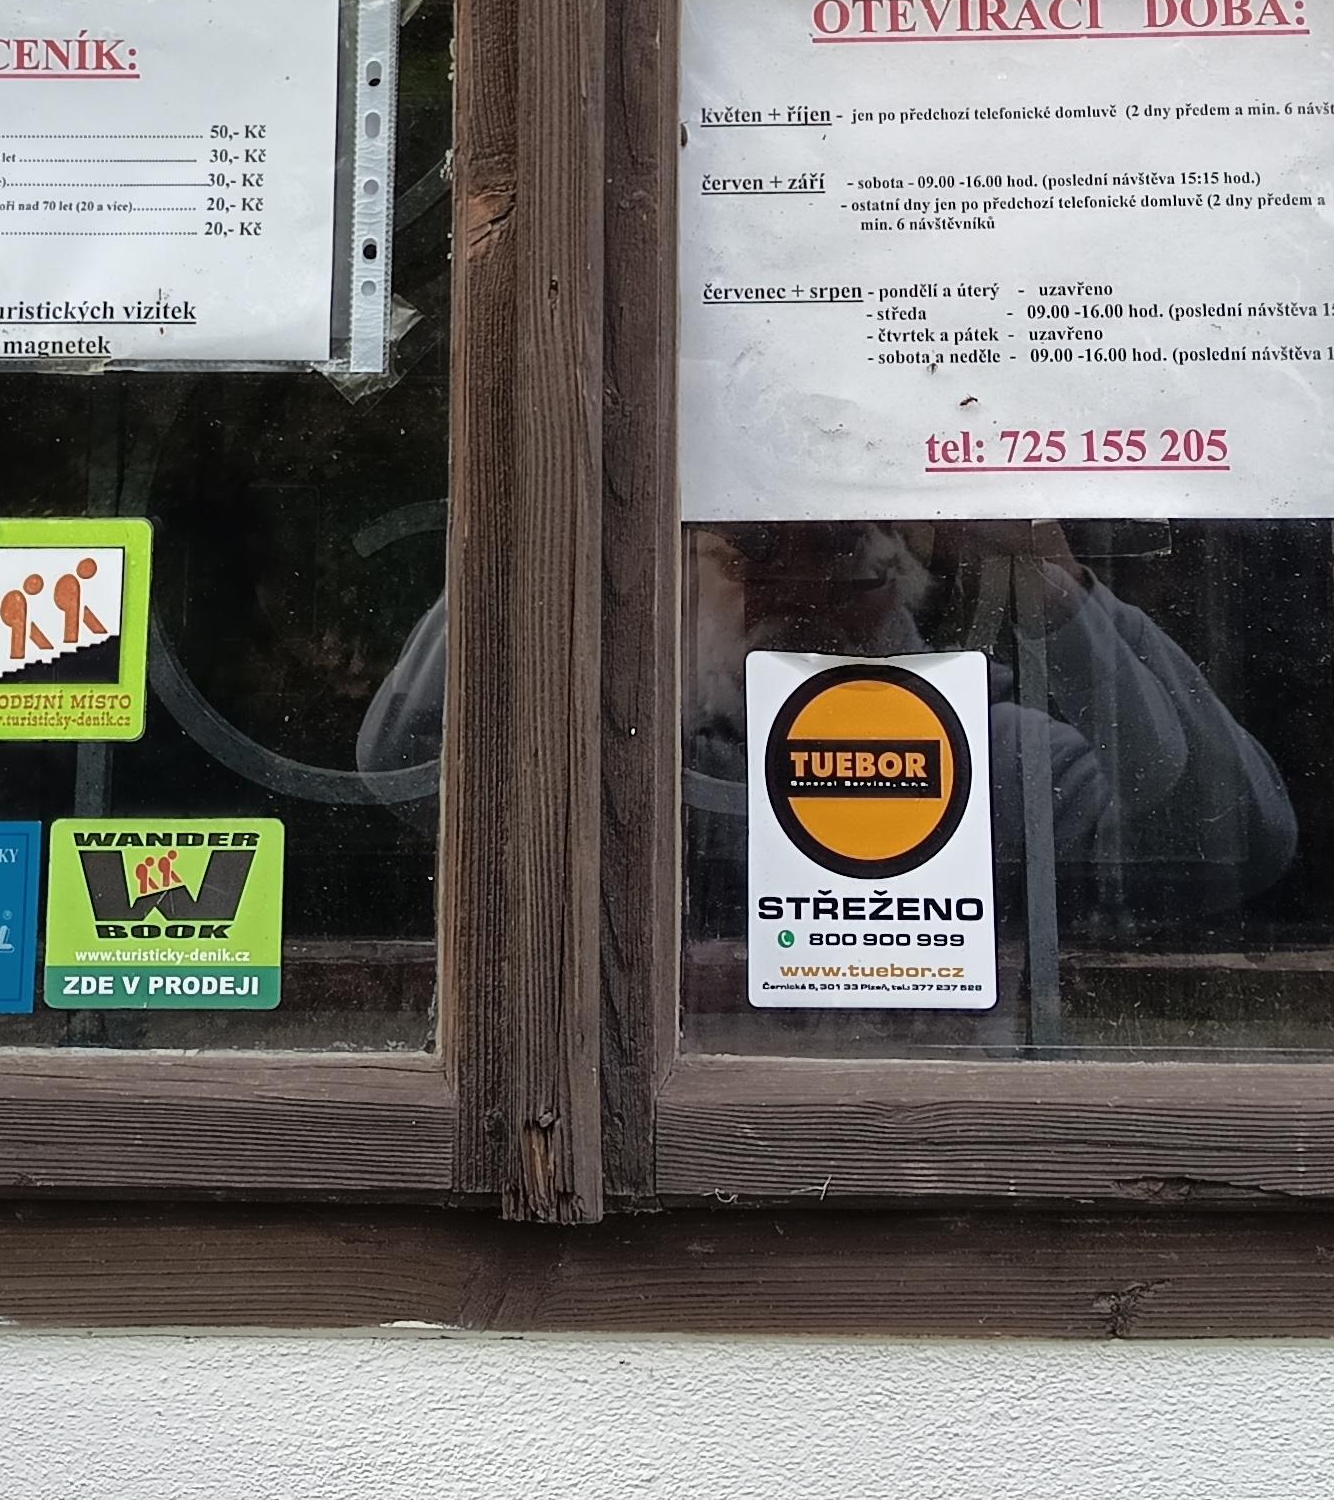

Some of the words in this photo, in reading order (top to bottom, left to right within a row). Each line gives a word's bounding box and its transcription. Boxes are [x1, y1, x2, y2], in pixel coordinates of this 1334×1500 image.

[702, 107, 761, 123] květen
[787, 106, 830, 124] říjen
[851, 109, 873, 123] jen
[900, 108, 970, 123] předchozí
[975, 106, 1050, 120] telefonické
[1055, 105, 1116, 118] domluvě
[1126, 105, 1139, 120] (2
[1144, 104, 1171, 120] dny
[1176, 103, 1230, 119] předem
[1248, 103, 1280, 115] min.
[210, 125, 239, 140] 50,-
[245, 125, 266, 138] Kč
[2, 153, 15, 162] let
[210, 149, 239, 164] 30,-
[245, 149, 266, 162] Kč
[208, 173, 236, 188] 30,-
[242, 173, 263, 187] Kč
[702, 175, 763, 190] červen
[788, 173, 824, 189] září
[858, 177, 904, 189] sobota
[918, 176, 954, 188] 09.00
[959, 175, 1002, 187] -16.00
[1007, 175, 1037, 187] hod.
[1043, 173, 1107, 189] (poslední
[1113, 172, 1175, 185] návštěva
[1181, 172, 1219, 184] 15:15
[1224, 172, 1260, 186] hod.)
[18, 201, 39, 210] nad
[43, 201, 56, 210] 70
[59, 201, 72, 211] let
[76, 201, 94, 213] (20
[107, 201, 132, 213] více)
[207, 197, 236, 213] 20,-
[242, 198, 263, 211] Kč
[852, 198, 900, 211] ostatní
[904, 198, 930, 214] dny
[934, 198, 956, 213] jen
[984, 196, 1054, 213] předchozí
[1059, 195, 1136, 208] telefonické
[1141, 194, 1203, 207] domluvě
[1208, 194, 1221, 209] (2
[1226, 194, 1252, 209] dny
[1258, 193, 1312, 209] předem
[204, 222, 234, 237] 20,-
[240, 222, 261, 236] Kč
[861, 218, 892, 230] min.
[910, 216, 994, 230] návštěvníků
[704, 283, 785, 299] červenec
[810, 287, 861, 299] srpen
[879, 284, 937, 299] pondělí
[957, 283, 999, 299] úterý
[1039, 282, 1112, 296] uzavřeno
[123, 301, 196, 320] vizitek
[877, 306, 926, 320] středa
[1028, 305, 1069, 319] 09.00
[1074, 304, 1123, 318] -16.00
[1129, 304, 1163, 317] hod.
[1169, 303, 1242, 320] (poslední
[1248, 302, 1317, 316] návštěva
[878, 328, 935, 342] čtvrtek
[954, 327, 999, 343] pátek
[1029, 326, 1103, 341] uzavřeno
[3, 336, 111, 356] magnetek
[878, 350, 930, 364] sobota
[950, 349, 1000, 363] neděle
[1031, 348, 1072, 362] 09.00
[1078, 348, 1126, 362] -16.00
[1133, 348, 1167, 361] hod.
[1173, 347, 1246, 363] (poslední
[1252, 346, 1321, 360] návštěva
[925, 431, 984, 463] tel:
[998, 431, 1066, 463] 725
[1081, 430, 1146, 462] 155
[1160, 429, 1227, 462] 205
[70, 690, 131, 709] MÍSTO
[790, 752, 928, 778] TUEBOR
[73, 832, 260, 847] WANDER
[758, 889, 984, 921] STŘEŽENO
[95, 924, 233, 939] BOOK
[809, 933, 857, 946] 800
[862, 933, 911, 947] 900
[916, 933, 965, 947] 999
[75, 948, 250, 964] www.turisticky-denik.cz
[780, 963, 965, 978] www.tuebor.cz
[63, 976, 114, 995] ZDE
[122, 976, 141, 995] V
[148, 976, 259, 995] PRODEJI
